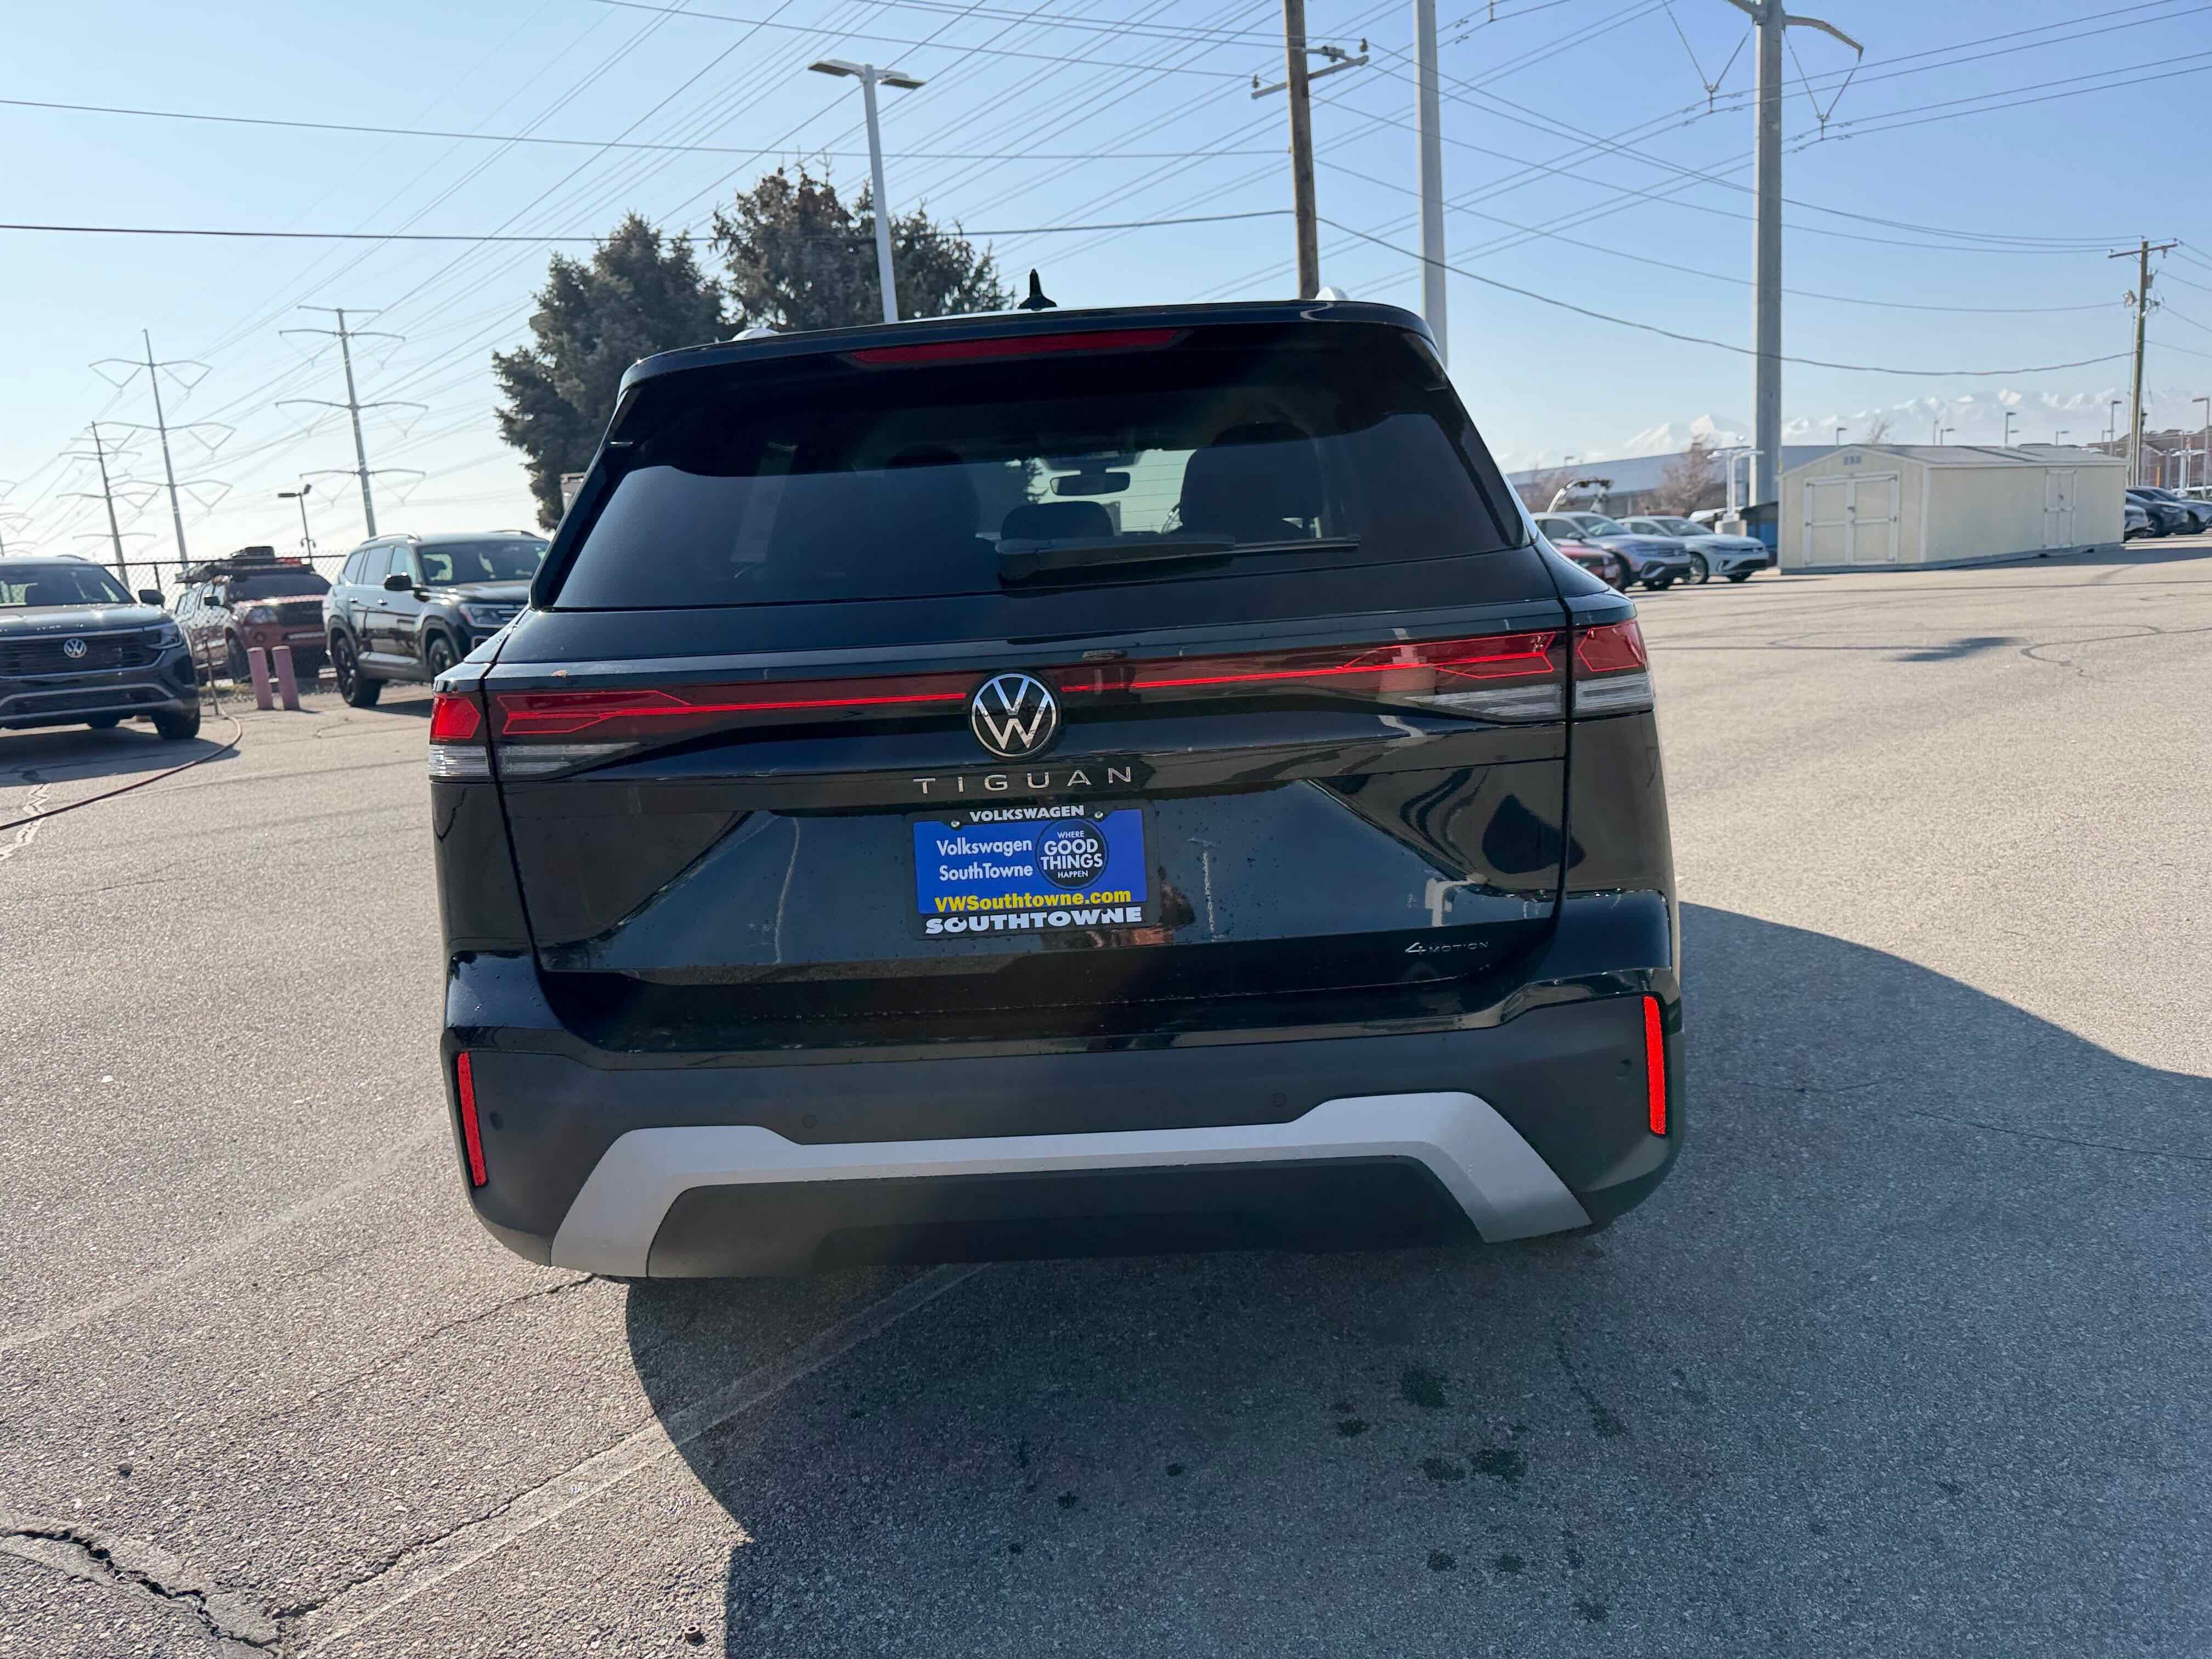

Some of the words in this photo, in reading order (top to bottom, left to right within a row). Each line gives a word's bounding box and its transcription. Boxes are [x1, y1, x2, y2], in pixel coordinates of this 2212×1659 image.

[913, 766, 1132, 794] TIGUAN
[969, 805, 1085, 822] VOLKSWAGEN
[1057, 830, 1085, 839] WHERE
[936, 837, 1032, 857] Volkswagen
[1044, 838, 1098, 854] GOOD
[1041, 853, 1103, 870] THINGS
[939, 863, 1033, 881] SouthTowne
[1057, 870, 1088, 879] HAPPEN
[935, 890, 1131, 912] VWSouthtowne.com
[926, 906, 1142, 935] SOUTHTOWNE
